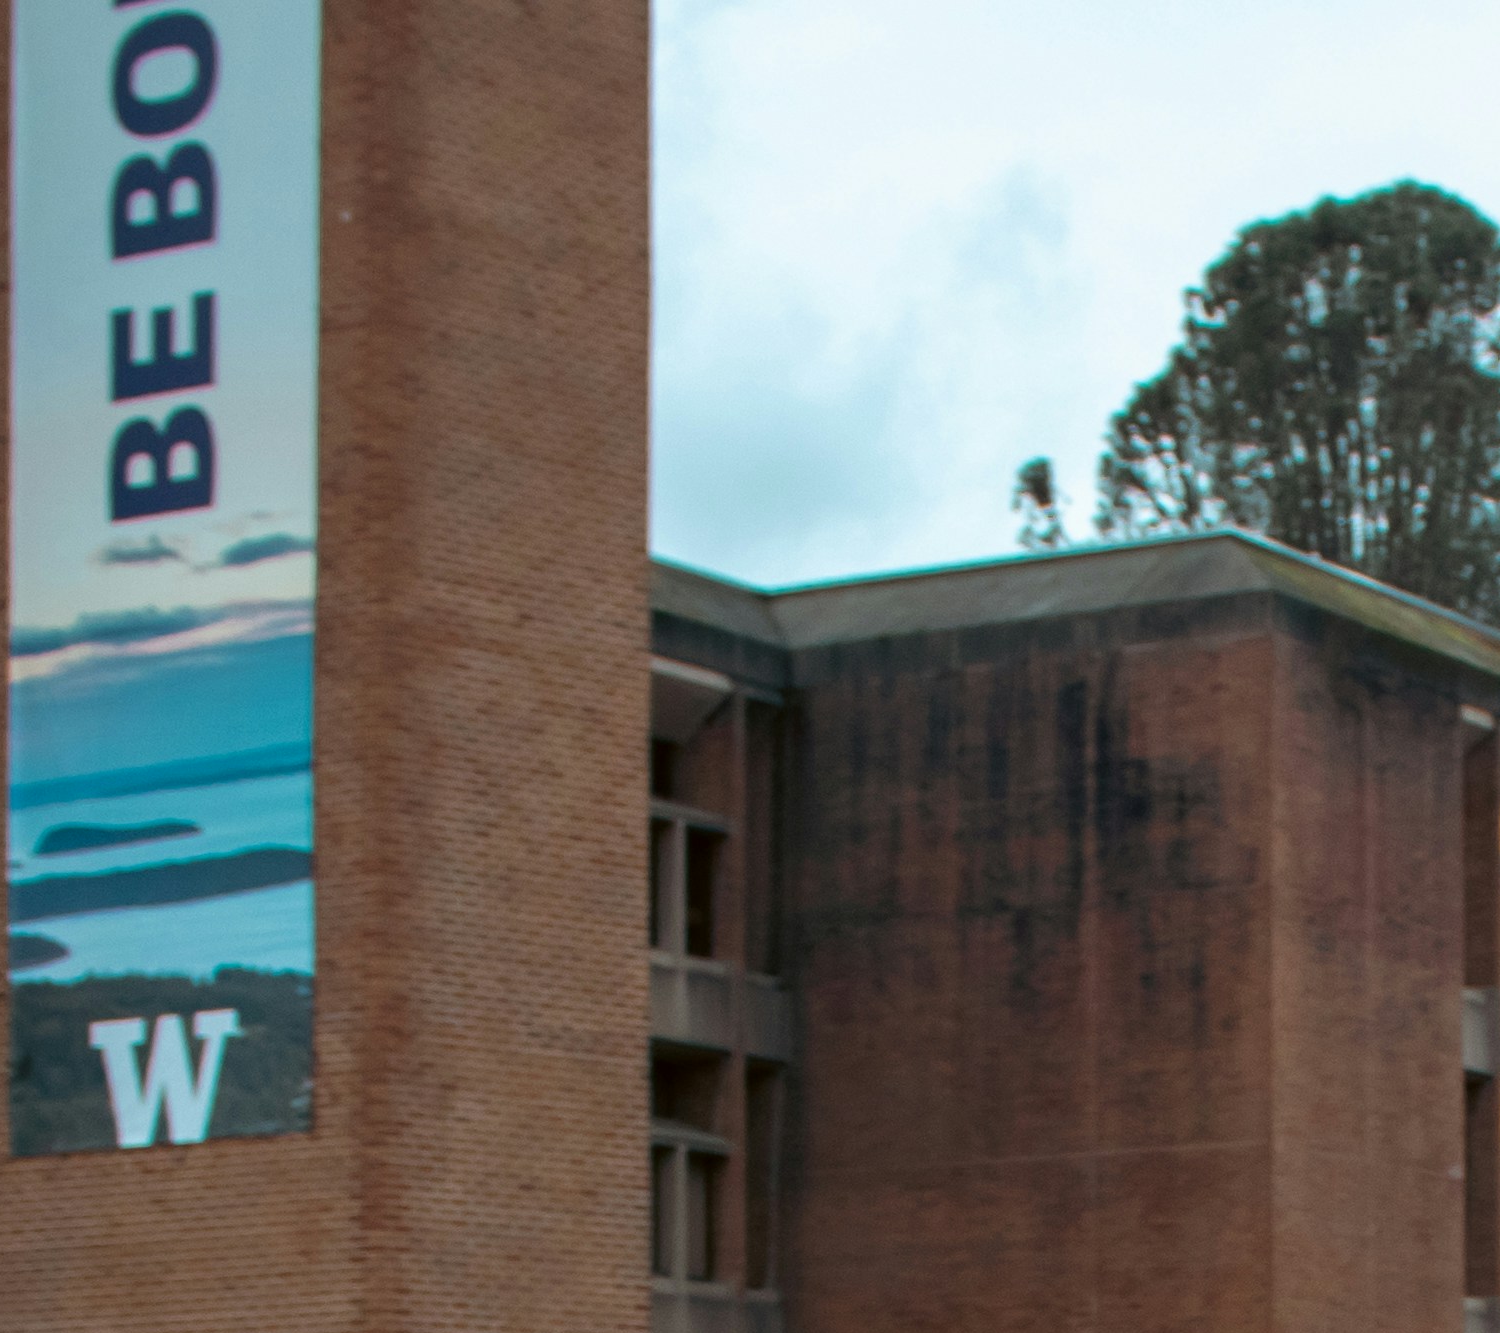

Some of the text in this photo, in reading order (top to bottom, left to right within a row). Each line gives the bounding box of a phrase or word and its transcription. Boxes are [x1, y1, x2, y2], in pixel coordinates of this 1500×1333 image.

[111, 0, 220, 524] BE BO
[88, 1007, 245, 1149] W
